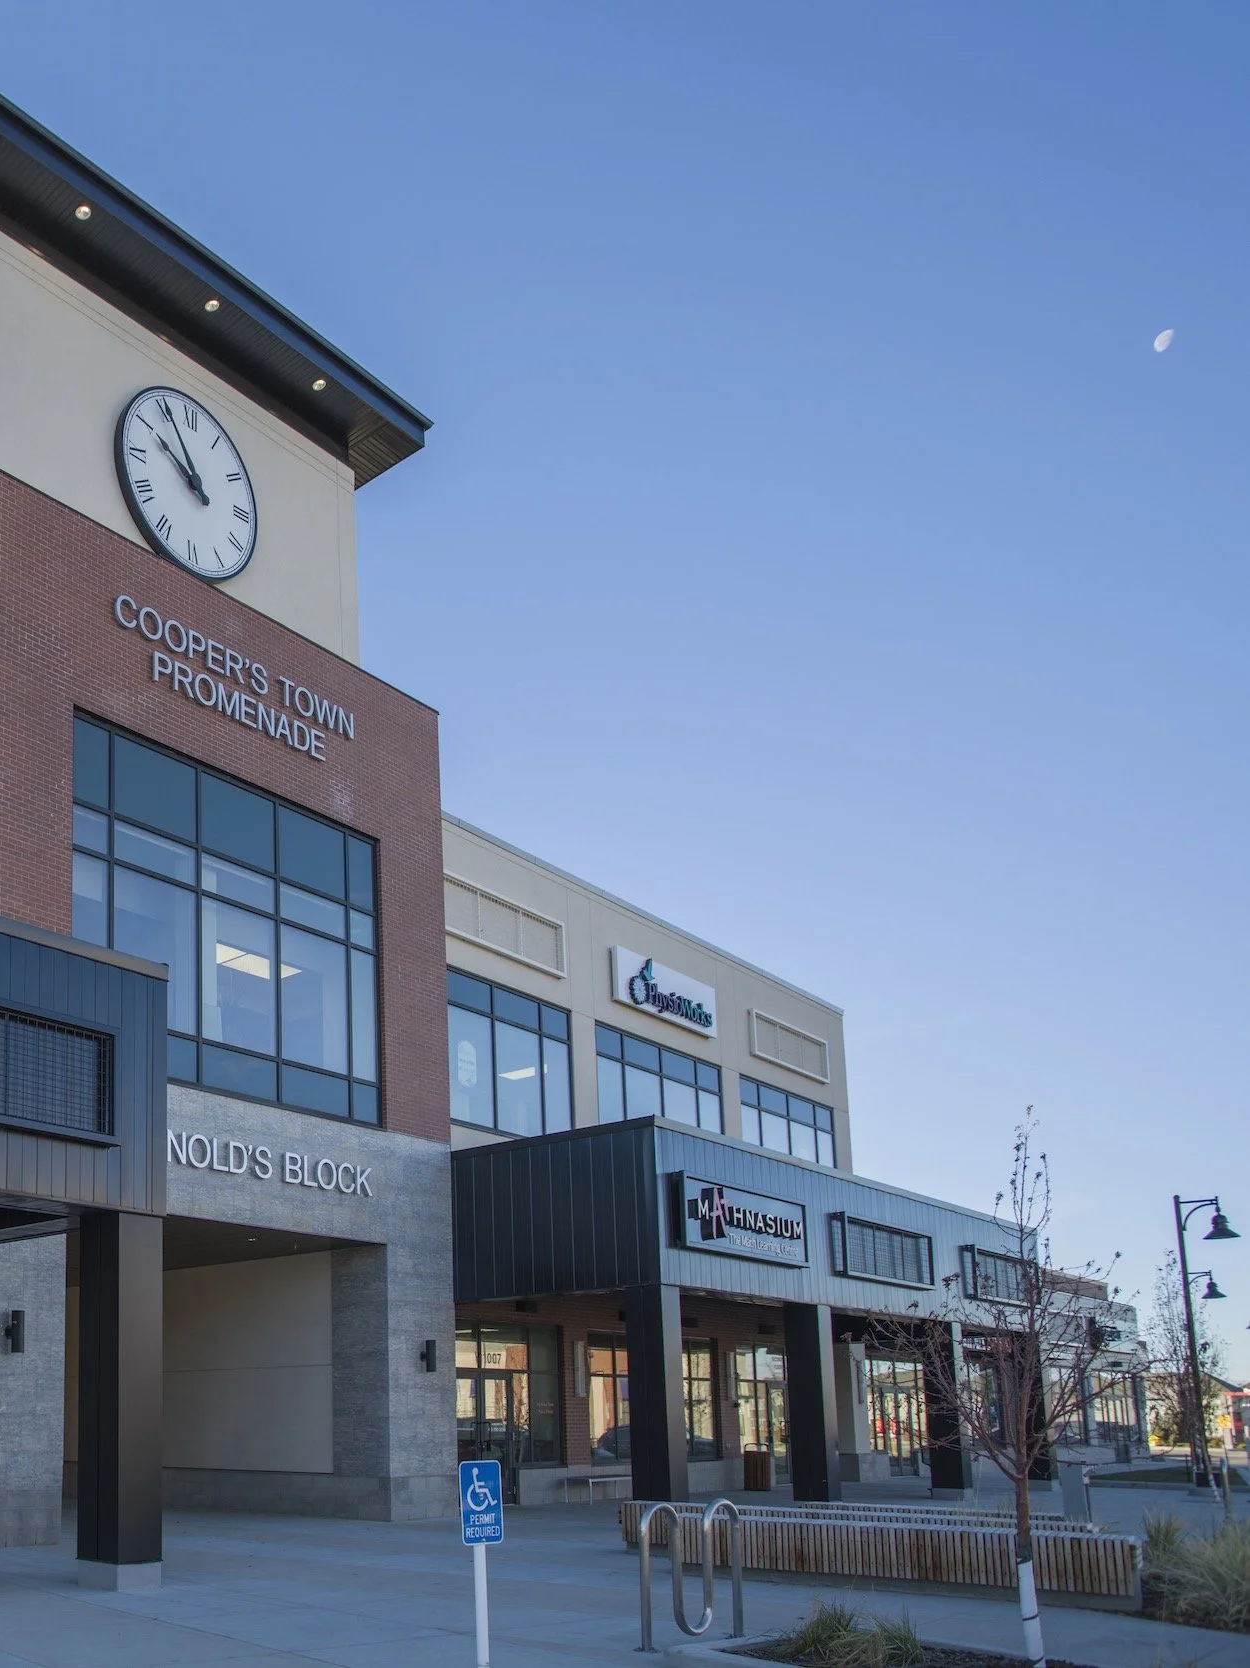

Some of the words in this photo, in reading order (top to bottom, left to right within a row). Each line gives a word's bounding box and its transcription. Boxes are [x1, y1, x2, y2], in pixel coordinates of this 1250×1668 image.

[183, 404, 198, 432] XII
[129, 439, 146, 464] IX
[226, 473, 242, 482] II
[135, 479, 155, 504] VIII
[233, 504, 249, 524] III
[156, 514, 173, 541] VII
[113, 594, 269, 695] COOPER'S
[278, 676, 355, 741] TOWN
[152, 650, 327, 761] PROMENADE
[646, 981, 713, 1028] PhysioWorks
[167, 1129, 273, 1179] NOLD'S
[284, 1151, 373, 1197] BLOCK
[696, 1186, 804, 1240] MATHNASIUM
[729, 1232, 741, 1245] The
[741, 1235, 756, 1249] Math
[756, 1238, 781, 1256] Learning
[465, 1525, 501, 1538] REQUIRED
[469, 1513, 496, 1525] PERMIT
